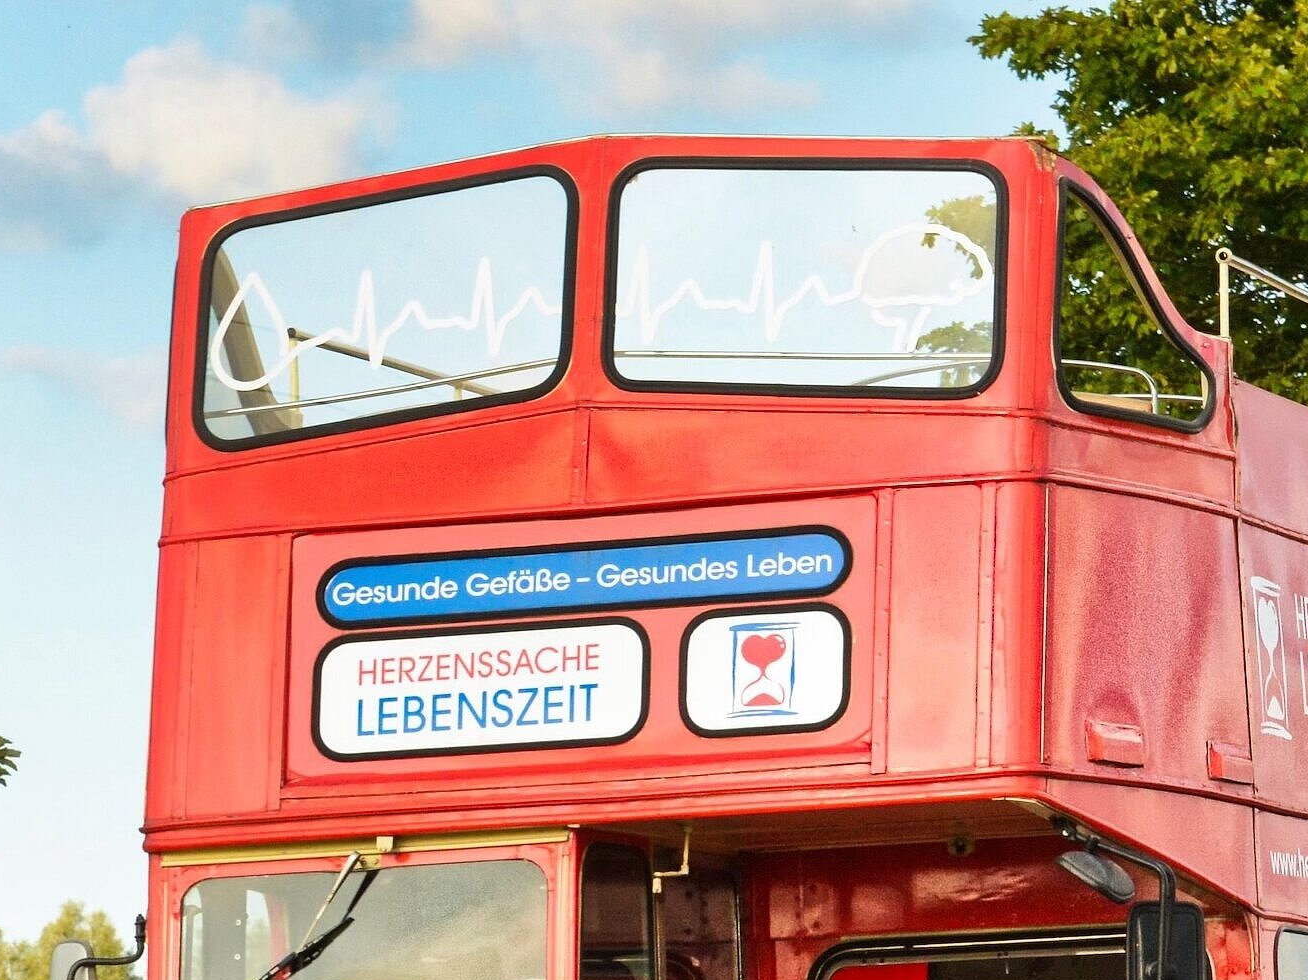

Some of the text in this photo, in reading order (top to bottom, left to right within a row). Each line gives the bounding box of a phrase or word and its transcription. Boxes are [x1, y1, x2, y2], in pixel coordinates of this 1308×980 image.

[332, 574, 458, 607] Gesunde
[465, 567, 571, 599] Gefäße
[596, 558, 739, 589] Gesundes
[746, 551, 833, 579] Leben
[357, 643, 601, 687] HERZENSSACHE
[356, 683, 600, 737] LEBENSZEIT
